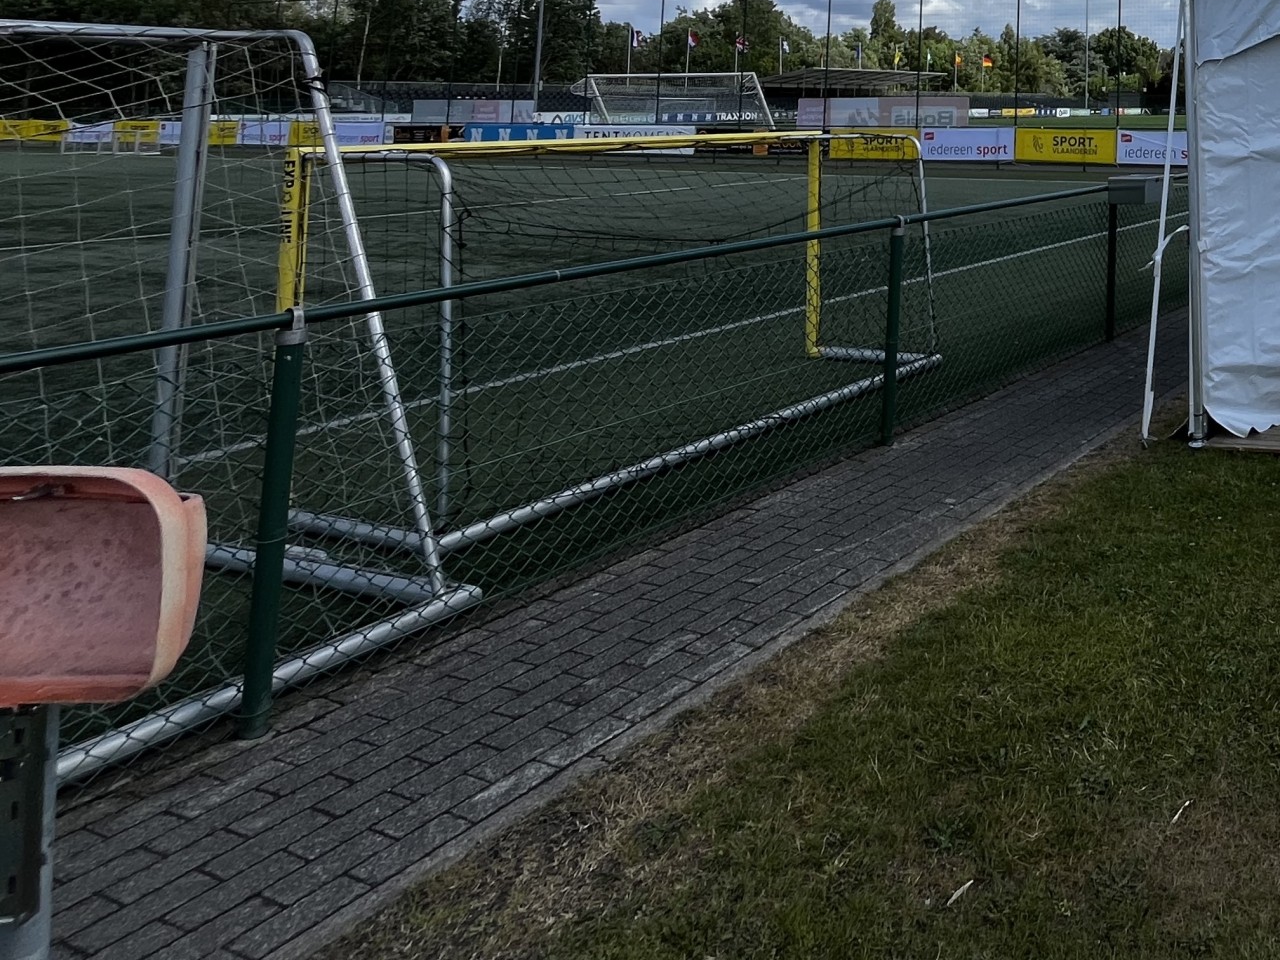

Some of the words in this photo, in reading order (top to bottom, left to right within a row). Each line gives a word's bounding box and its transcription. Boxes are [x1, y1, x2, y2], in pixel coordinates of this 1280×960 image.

[1053, 135, 1098, 148] SPORT.
[927, 143, 973, 155] iedereen
[976, 144, 1008, 157] sport
[1053, 147, 1098, 156] VLAANDEREN
[1124, 146, 1176, 159] iedereen
